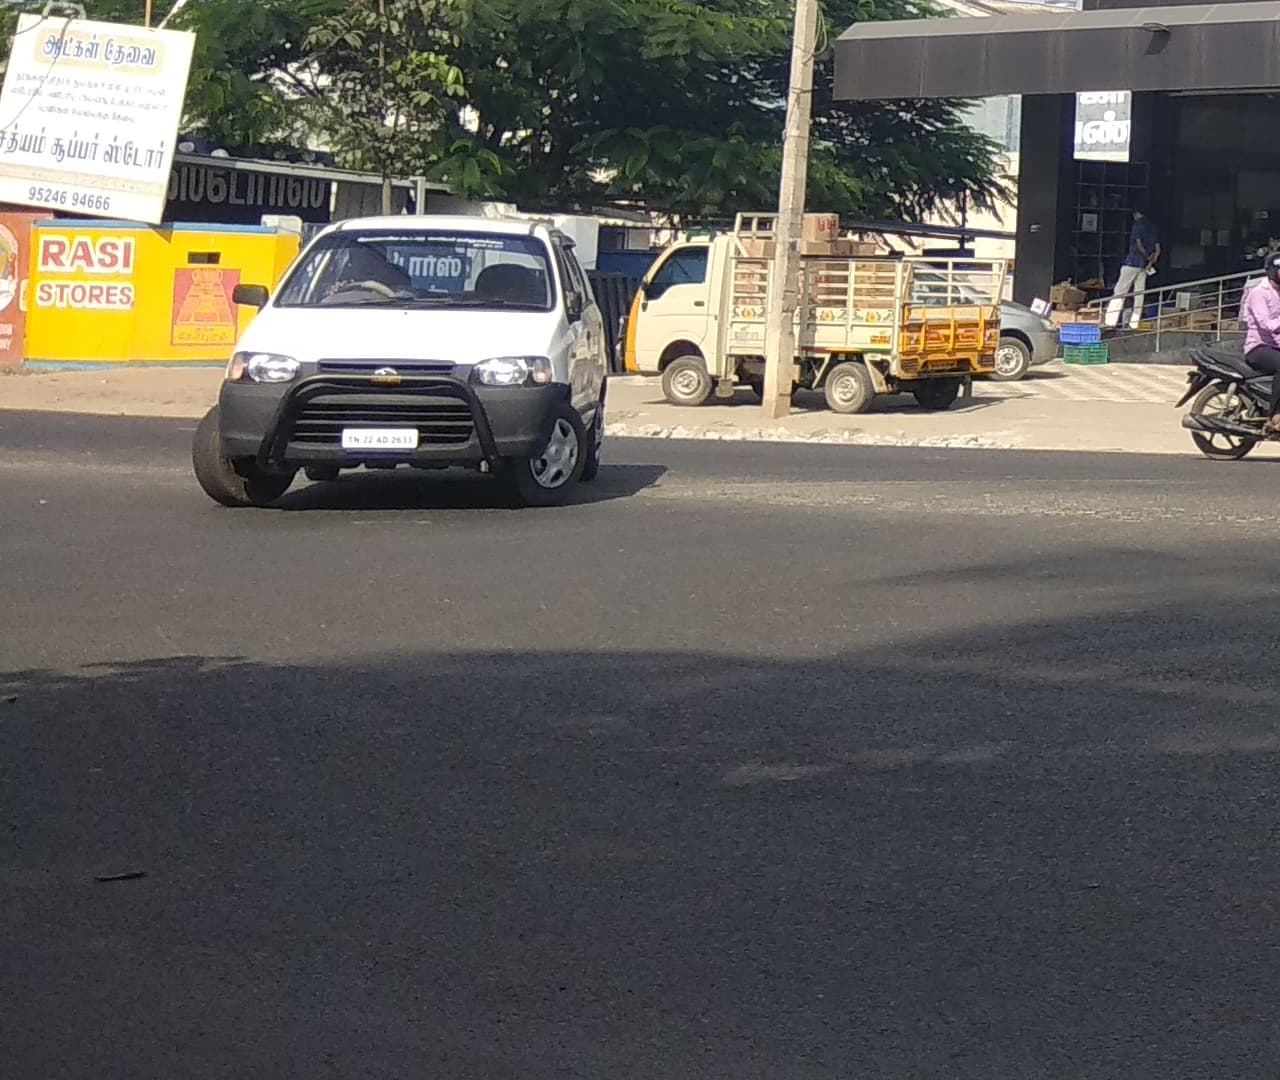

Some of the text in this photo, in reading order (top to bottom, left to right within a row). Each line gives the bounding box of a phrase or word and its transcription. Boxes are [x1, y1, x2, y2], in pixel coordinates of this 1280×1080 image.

[104, 38, 156, 66] தேவை
[28, 185, 111, 211] 95246 94666
[41, 239, 132, 269] RASI
[38, 282, 133, 306] STORES
